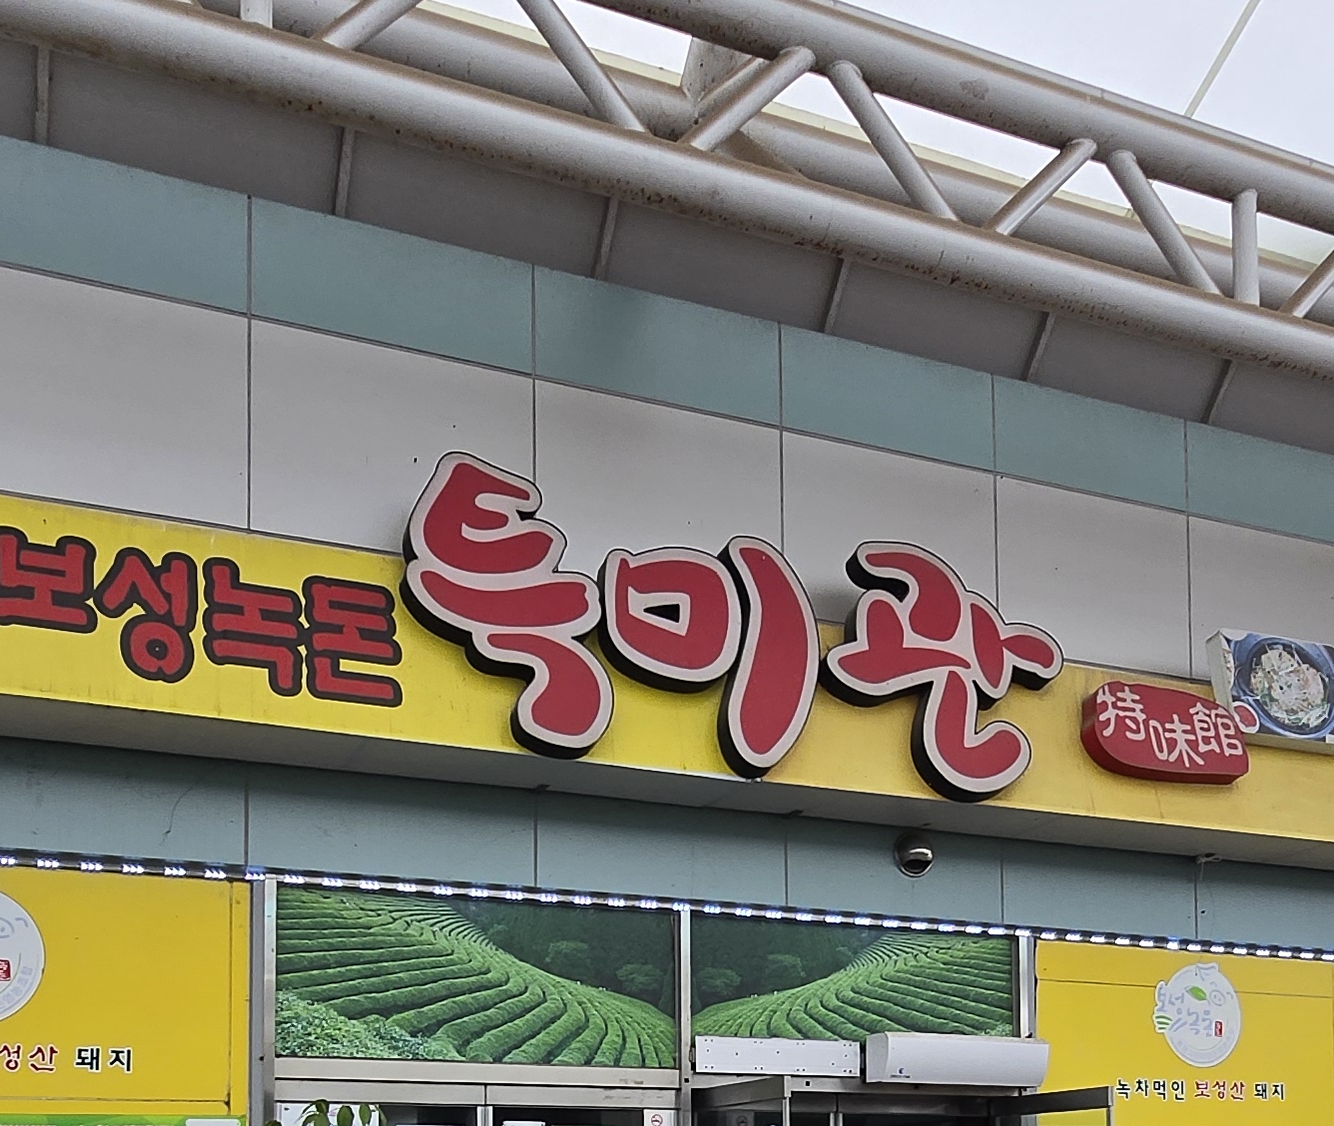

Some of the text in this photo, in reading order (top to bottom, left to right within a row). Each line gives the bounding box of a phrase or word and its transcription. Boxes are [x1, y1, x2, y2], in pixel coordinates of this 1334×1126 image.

[400, 451, 1064, 801] 특미관
[1097, 684, 1244, 769] 特味館
[73, 1044, 135, 1074] 돼지
[1116, 1078, 1285, 1101] 녹차먹인 보성산 돼지
